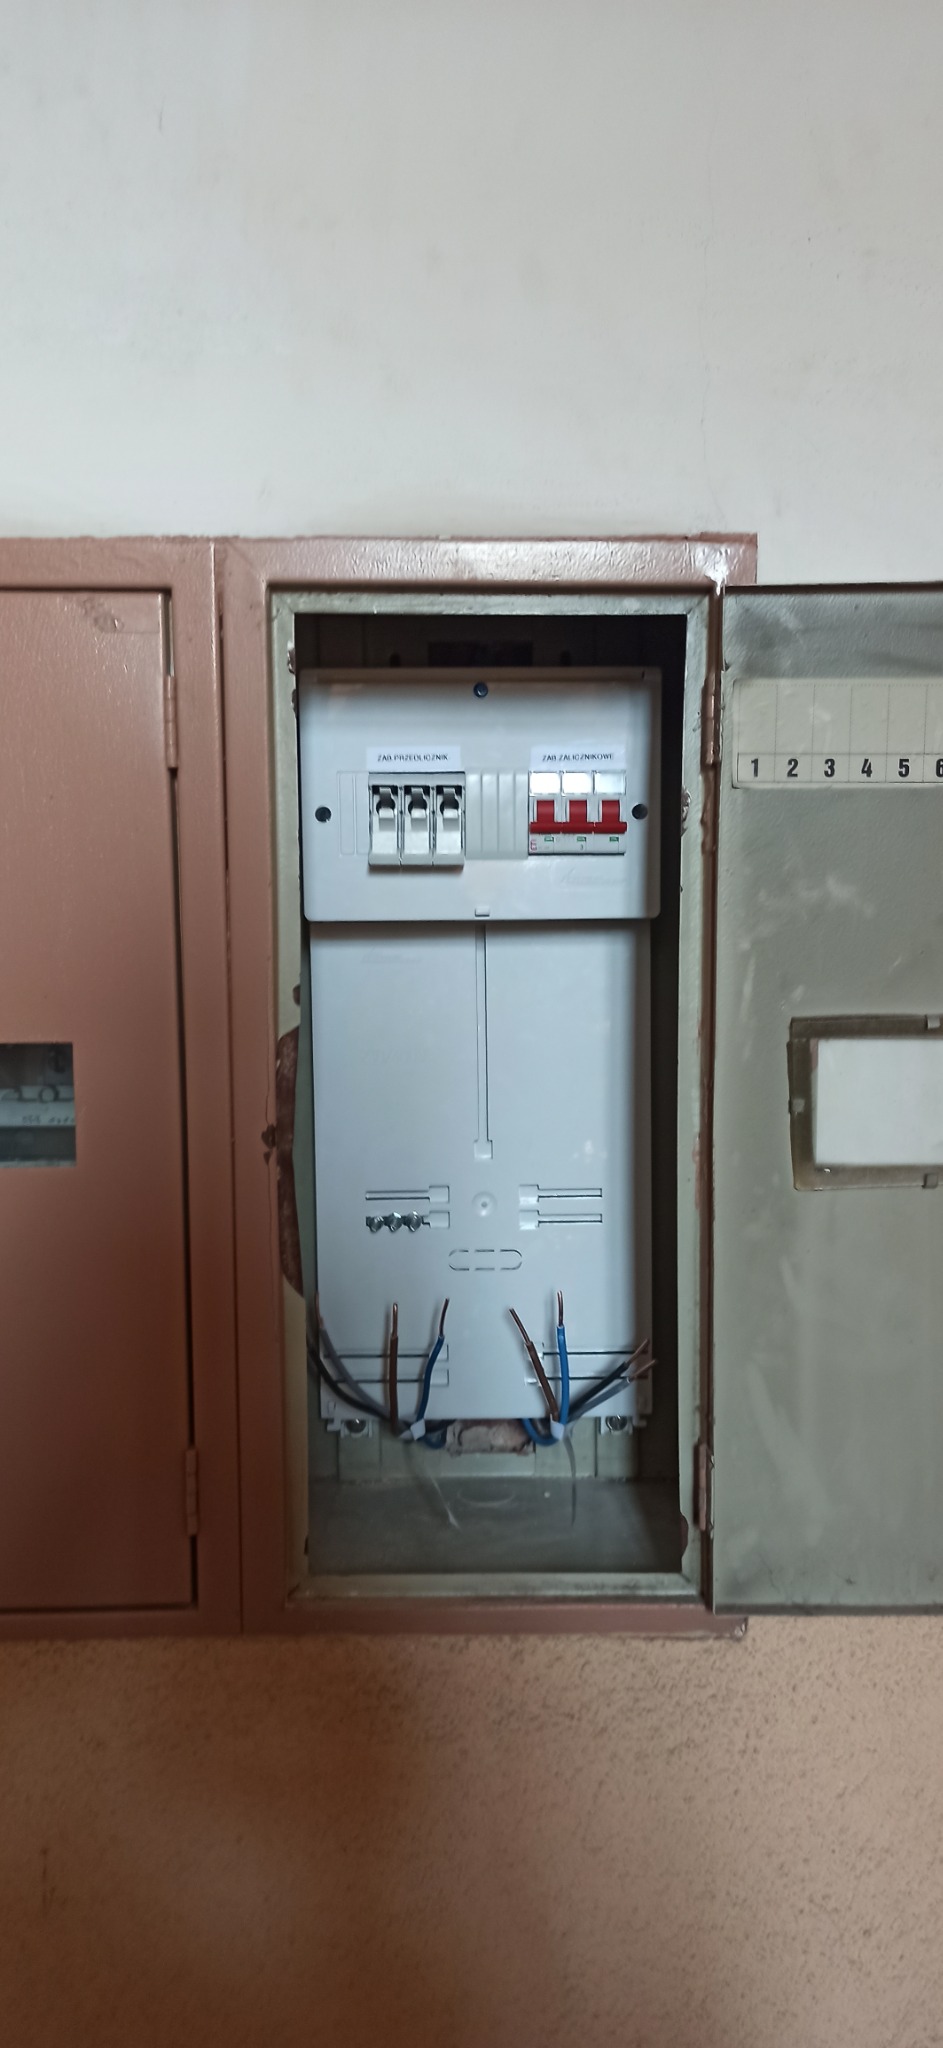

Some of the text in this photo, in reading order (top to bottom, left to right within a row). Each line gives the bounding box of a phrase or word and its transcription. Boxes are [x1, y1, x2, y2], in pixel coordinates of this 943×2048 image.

[751, 758, 943, 778] 1 2 3 4 5 6
